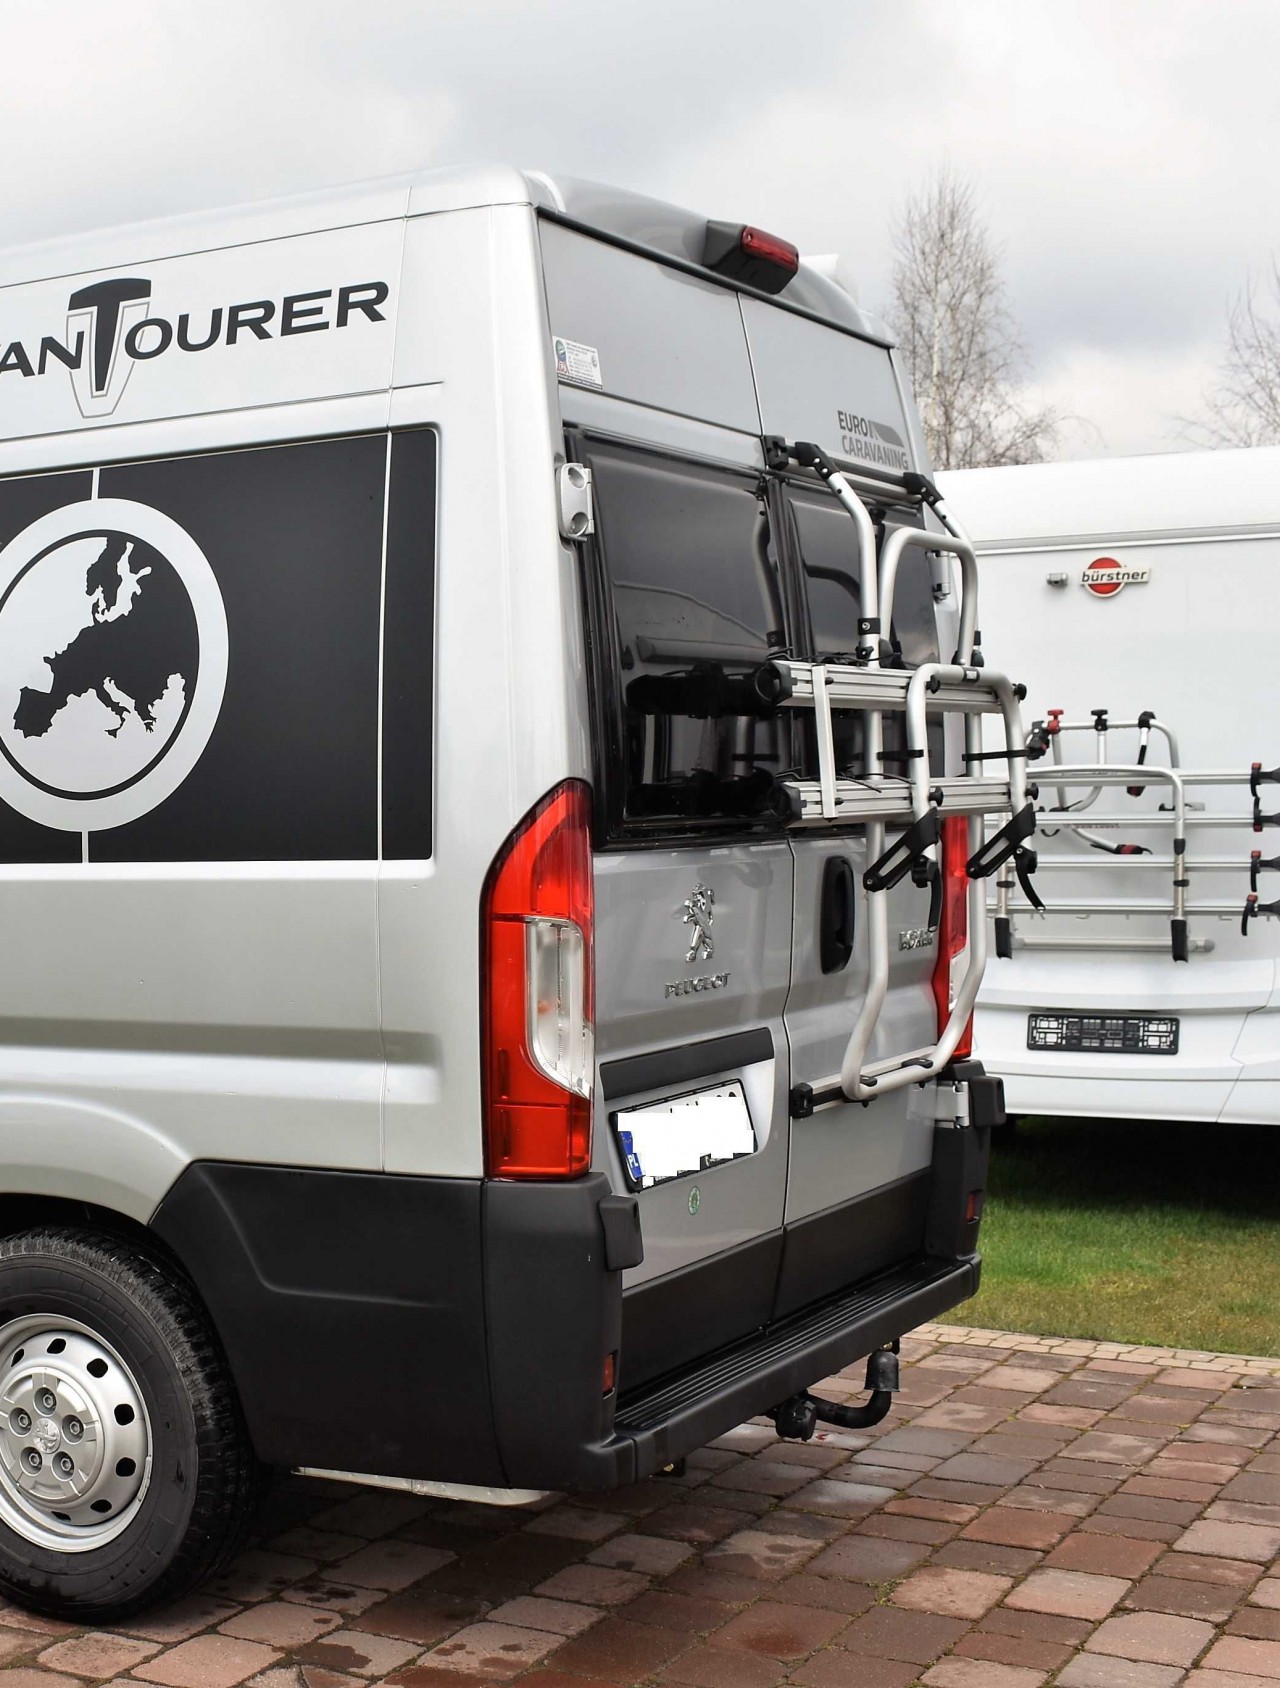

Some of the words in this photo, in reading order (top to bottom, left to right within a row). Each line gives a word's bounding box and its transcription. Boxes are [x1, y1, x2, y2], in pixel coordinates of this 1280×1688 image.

[837, 410, 869, 438] EURO
[841, 435, 909, 470] CARAVANING
[1081, 570, 1148, 583] bürstner
[665, 972, 731, 999] PEUGEOT
[626, 1152, 639, 1169] PL
